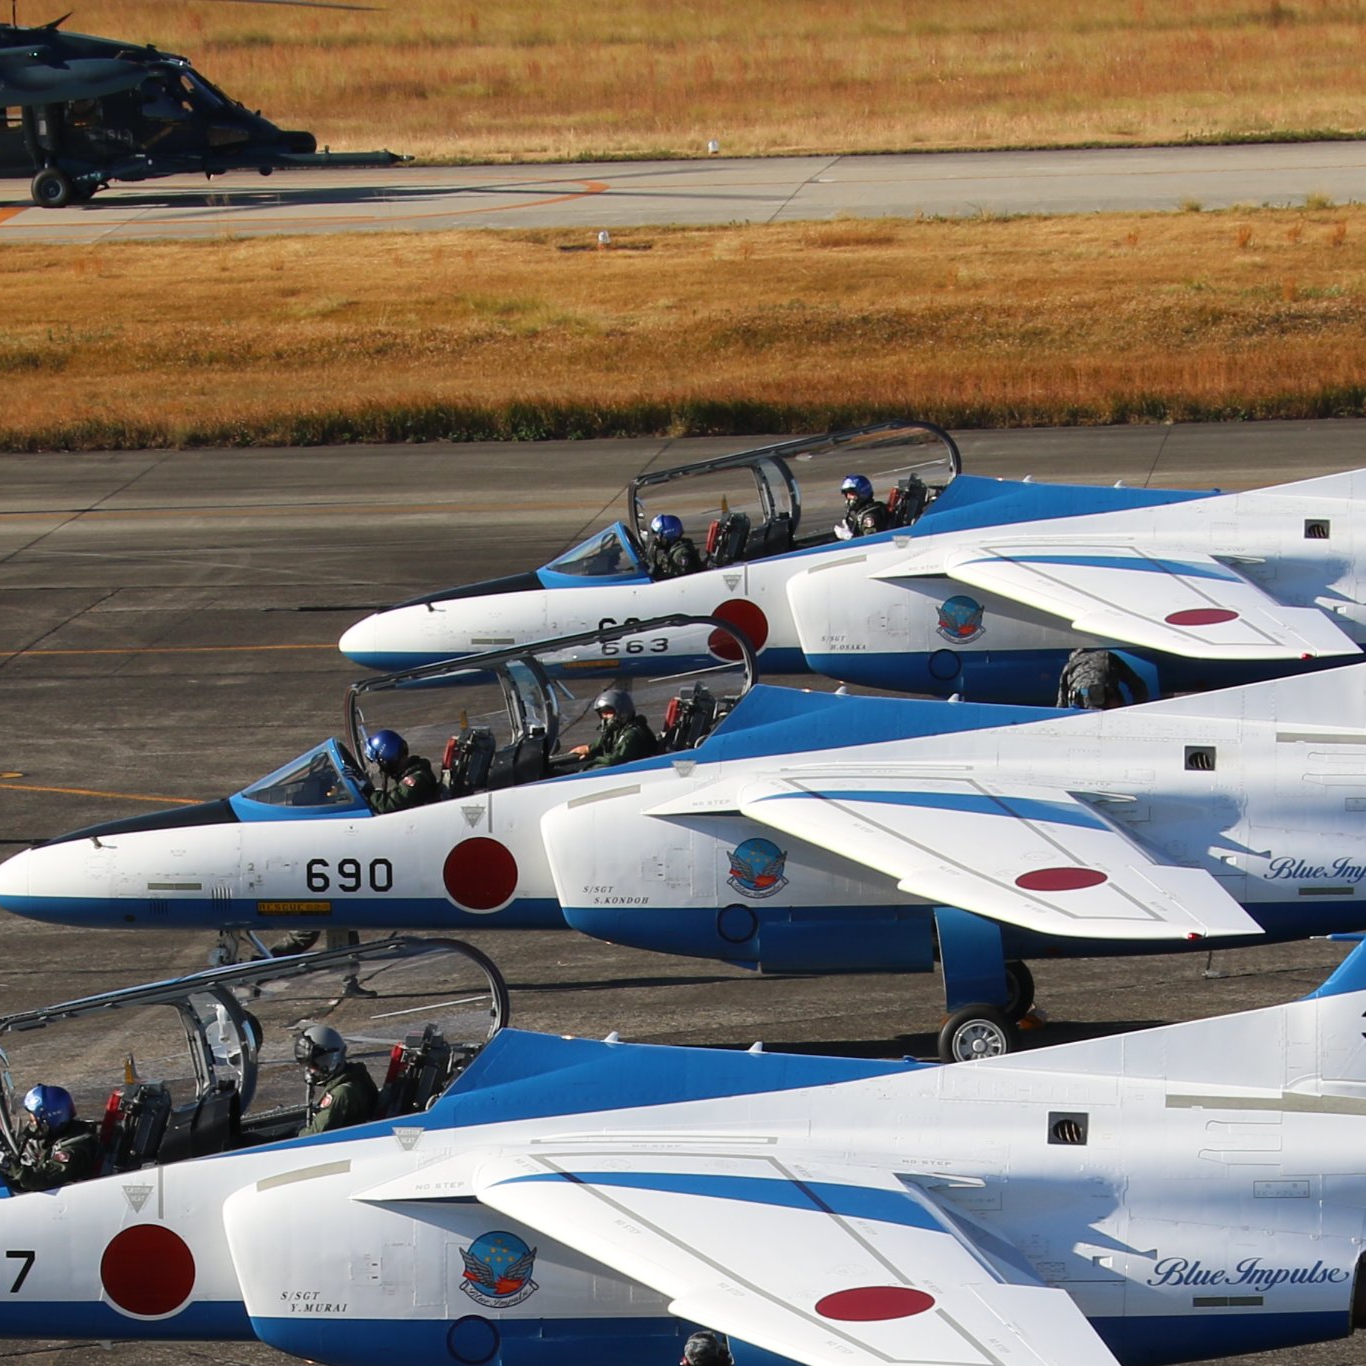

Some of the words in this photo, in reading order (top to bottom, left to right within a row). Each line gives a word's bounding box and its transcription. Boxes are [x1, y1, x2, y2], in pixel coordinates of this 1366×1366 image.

[1263, 856, 1325, 880] Blue
[306, 858, 393, 892] 690
[582, 885, 614, 894] S/SGT
[593, 896, 650, 905] S.KONDOH
[1146, 1256, 1226, 1286] Blue
[1225, 1256, 1350, 1291] Impulse
[280, 1291, 320, 1301] S/SGT
[290, 1303, 348, 1313] Y.MURAI
